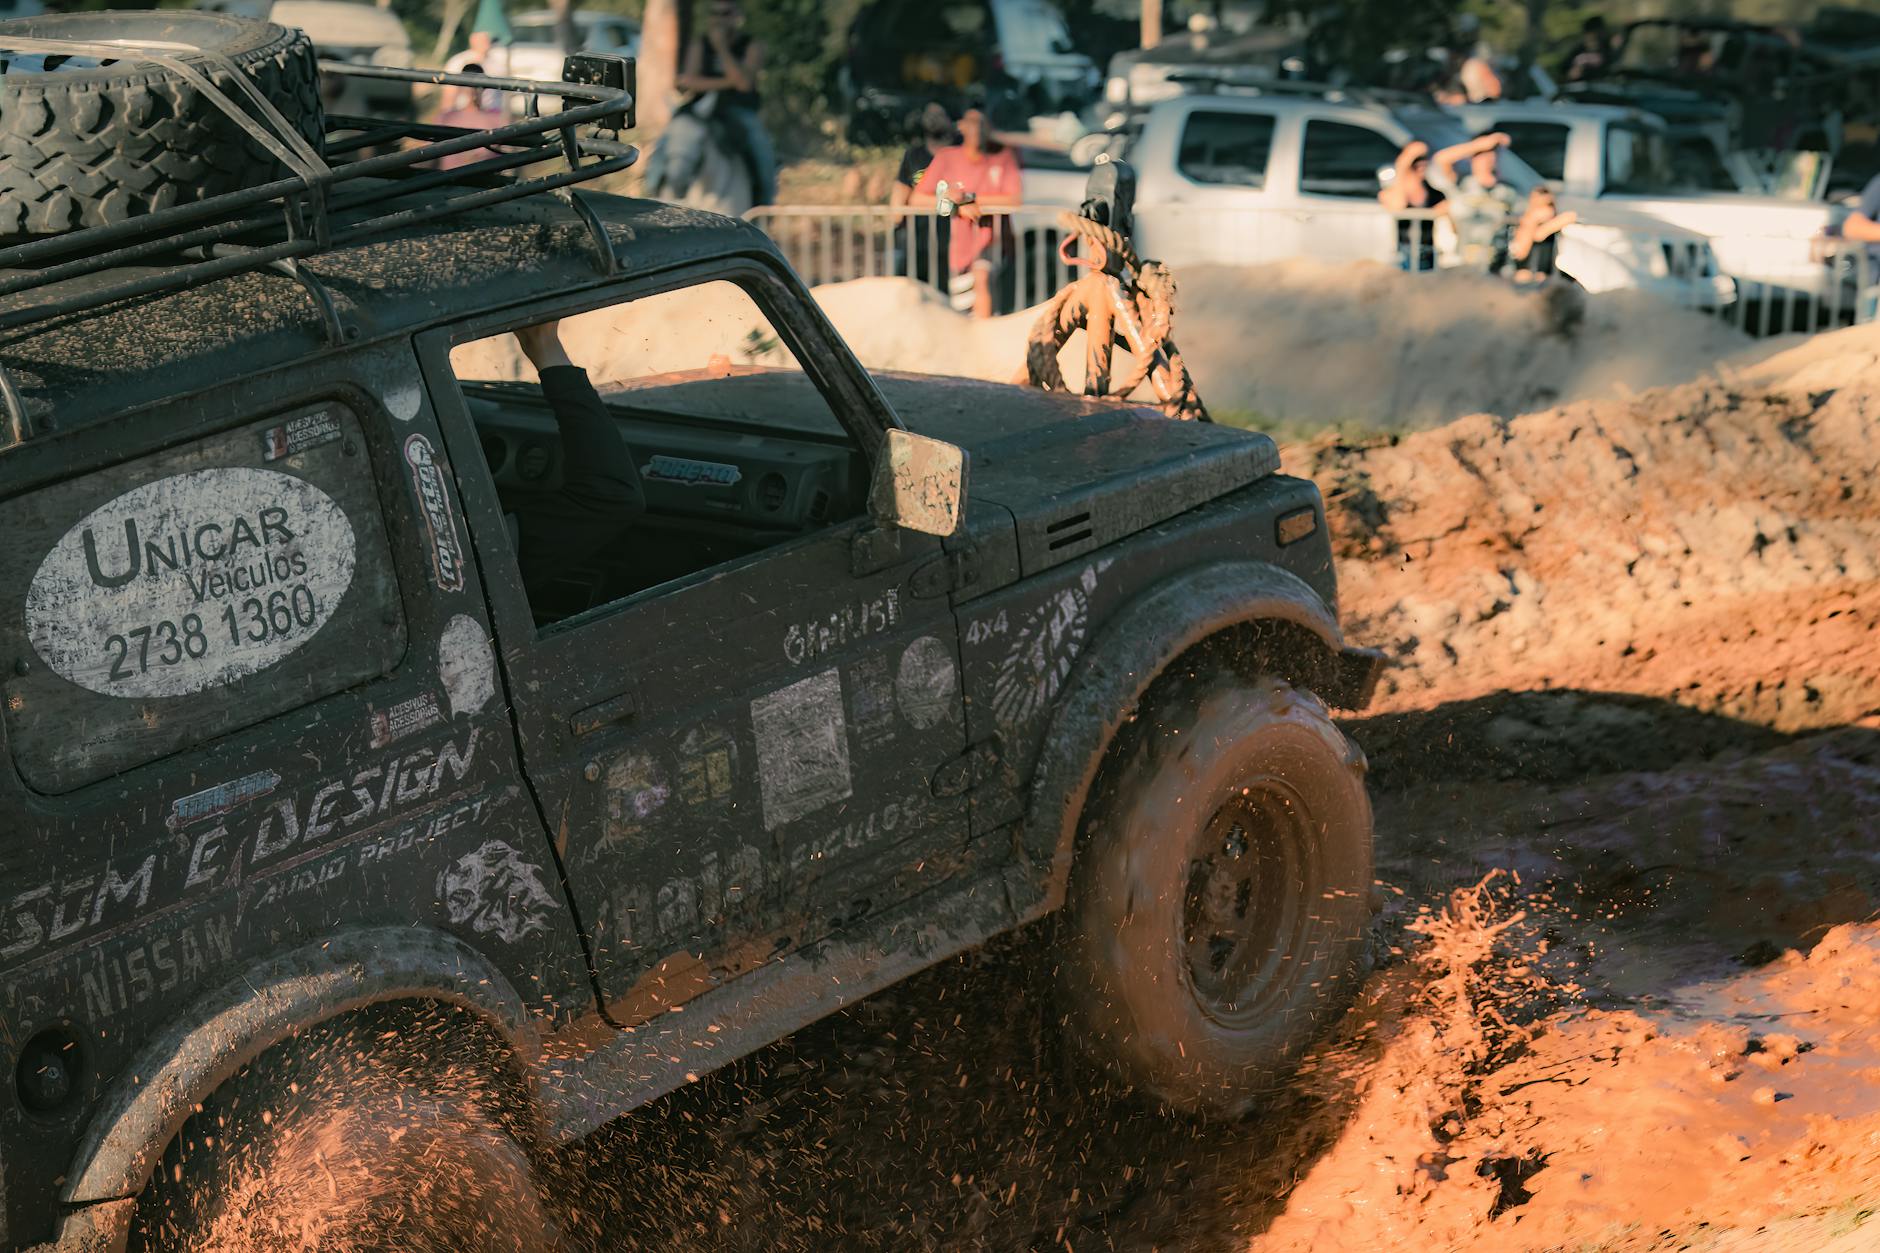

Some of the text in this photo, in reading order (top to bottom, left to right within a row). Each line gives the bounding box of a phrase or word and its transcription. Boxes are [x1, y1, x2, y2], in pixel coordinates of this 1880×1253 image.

[104, 584, 316, 682] 2738 1360
[965, 609, 1009, 646] 4x4
[183, 826, 229, 890] E
[250, 727, 483, 864] DESIGN
[81, 917, 235, 1024] NISSAN
